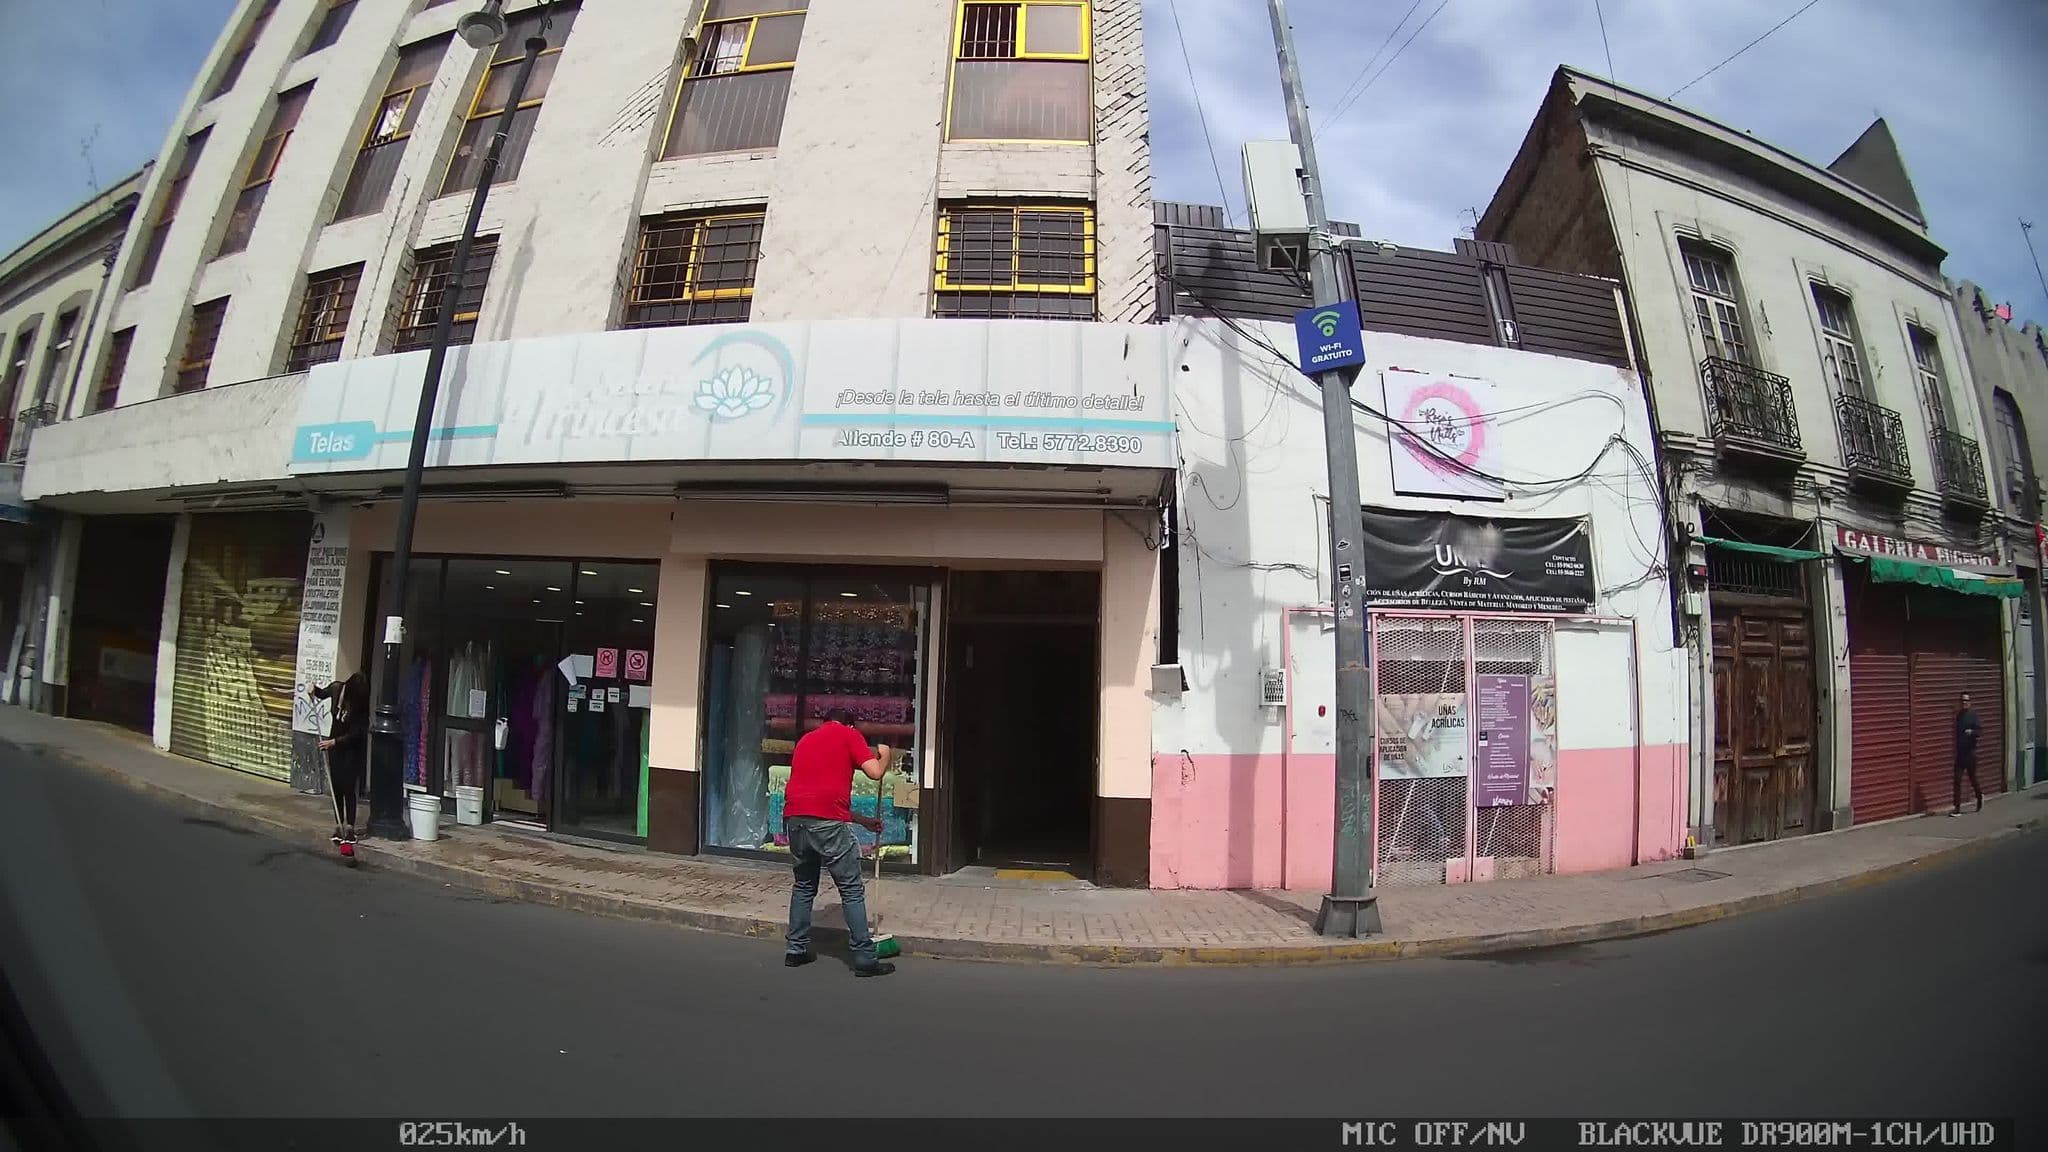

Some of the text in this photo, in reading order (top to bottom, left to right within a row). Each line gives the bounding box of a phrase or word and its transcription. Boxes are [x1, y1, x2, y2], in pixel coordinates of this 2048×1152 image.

[1320, 342, 1341, 352] WI-FI
[1312, 349, 1353, 363] GRATUITO
[836, 389, 1144, 411] ¡Desde la tela hasta el último detalle!
[309, 431, 355, 455] Telas
[837, 430, 1142, 453] Allende # 80-A Tel.: 5772.8390
[1845, 530, 1928, 560] GALERIA
[1463, 577, 1473, 586] By
[1438, 704, 1457, 716] UÑAS
[1432, 717, 1465, 729] ACRÍLICAS
[1380, 737, 1399, 745] CURSOS
